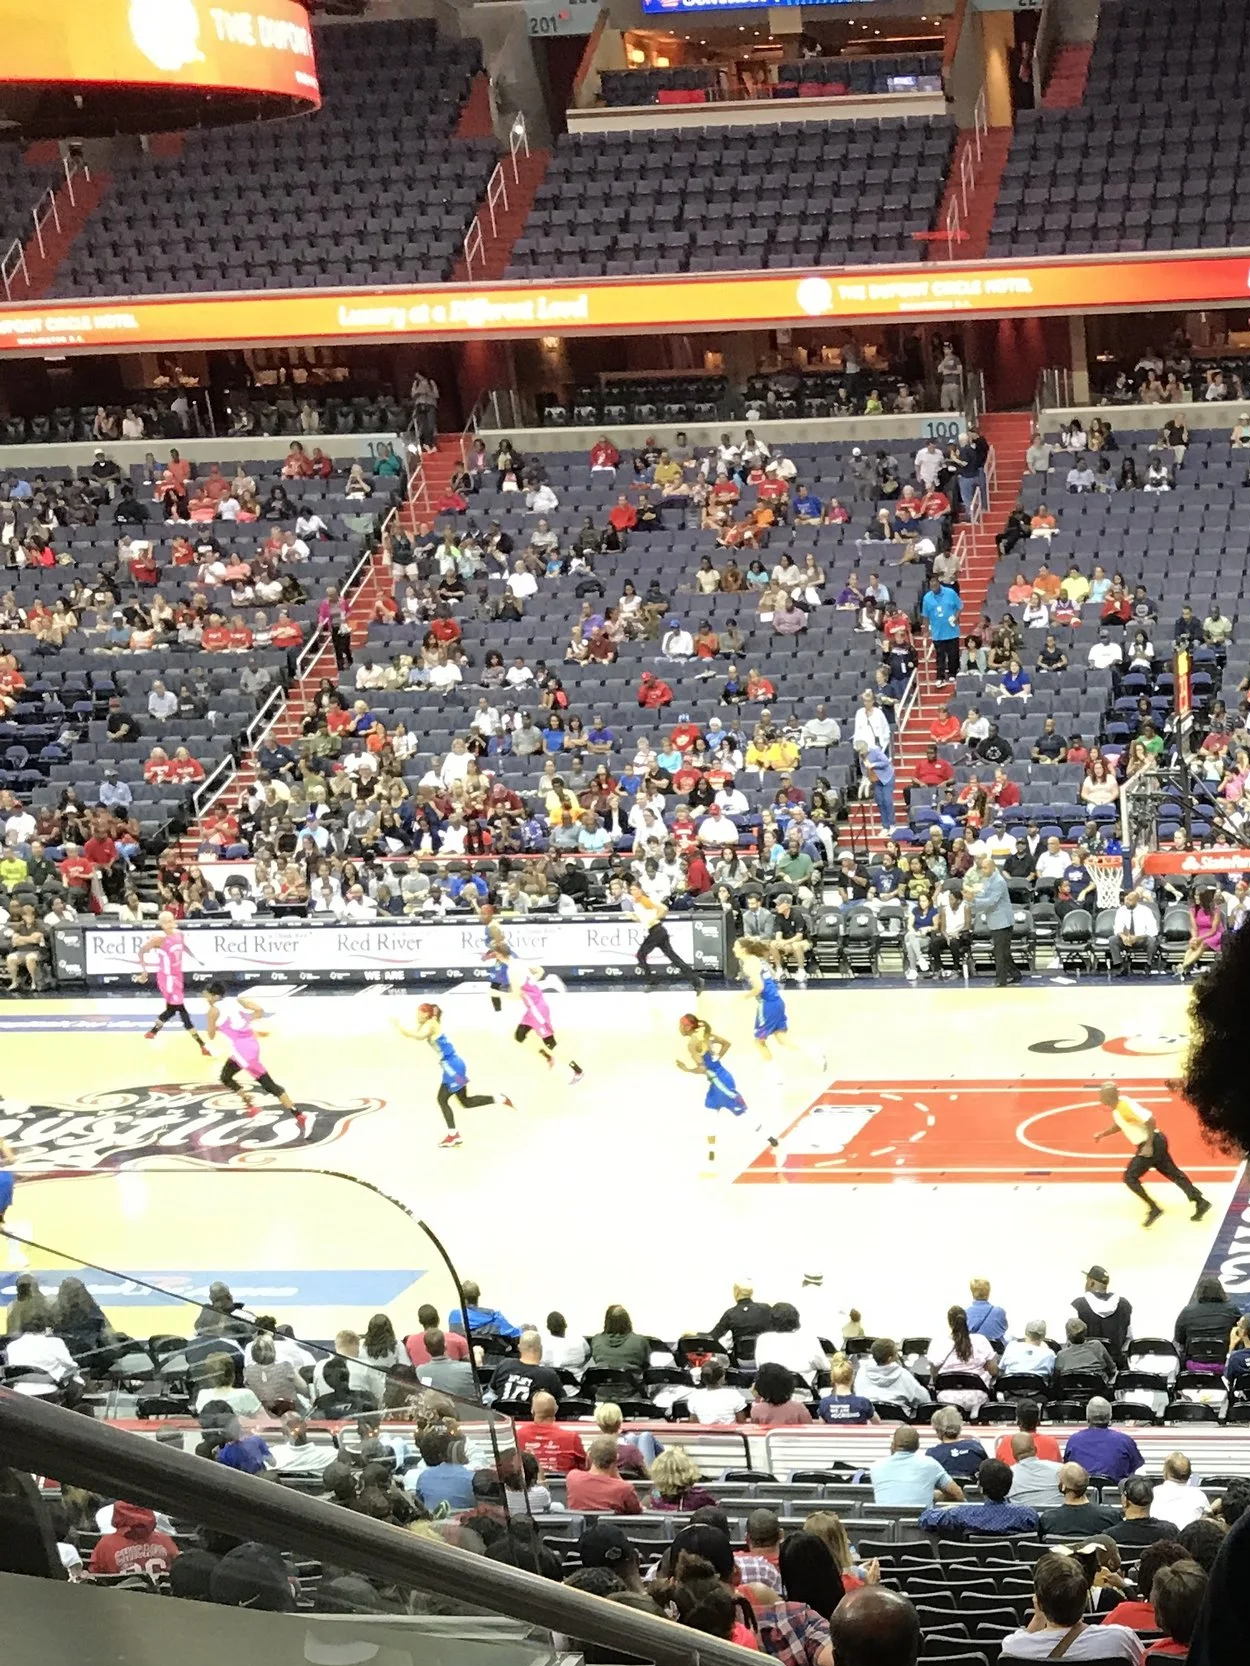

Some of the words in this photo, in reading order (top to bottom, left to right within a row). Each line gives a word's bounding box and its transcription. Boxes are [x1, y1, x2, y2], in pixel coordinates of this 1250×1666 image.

[530, 16, 558, 34] 201
[927, 421, 960, 438] 100
[93, 936, 126, 955] Red
[214, 934, 248, 953] Red
[254, 934, 300, 953] River
[338, 932, 371, 951] Red
[377, 931, 423, 951] River
[587, 928, 621, 947] Red
[364, 971, 381, 981] WE
[384, 970, 405, 980] ARE
